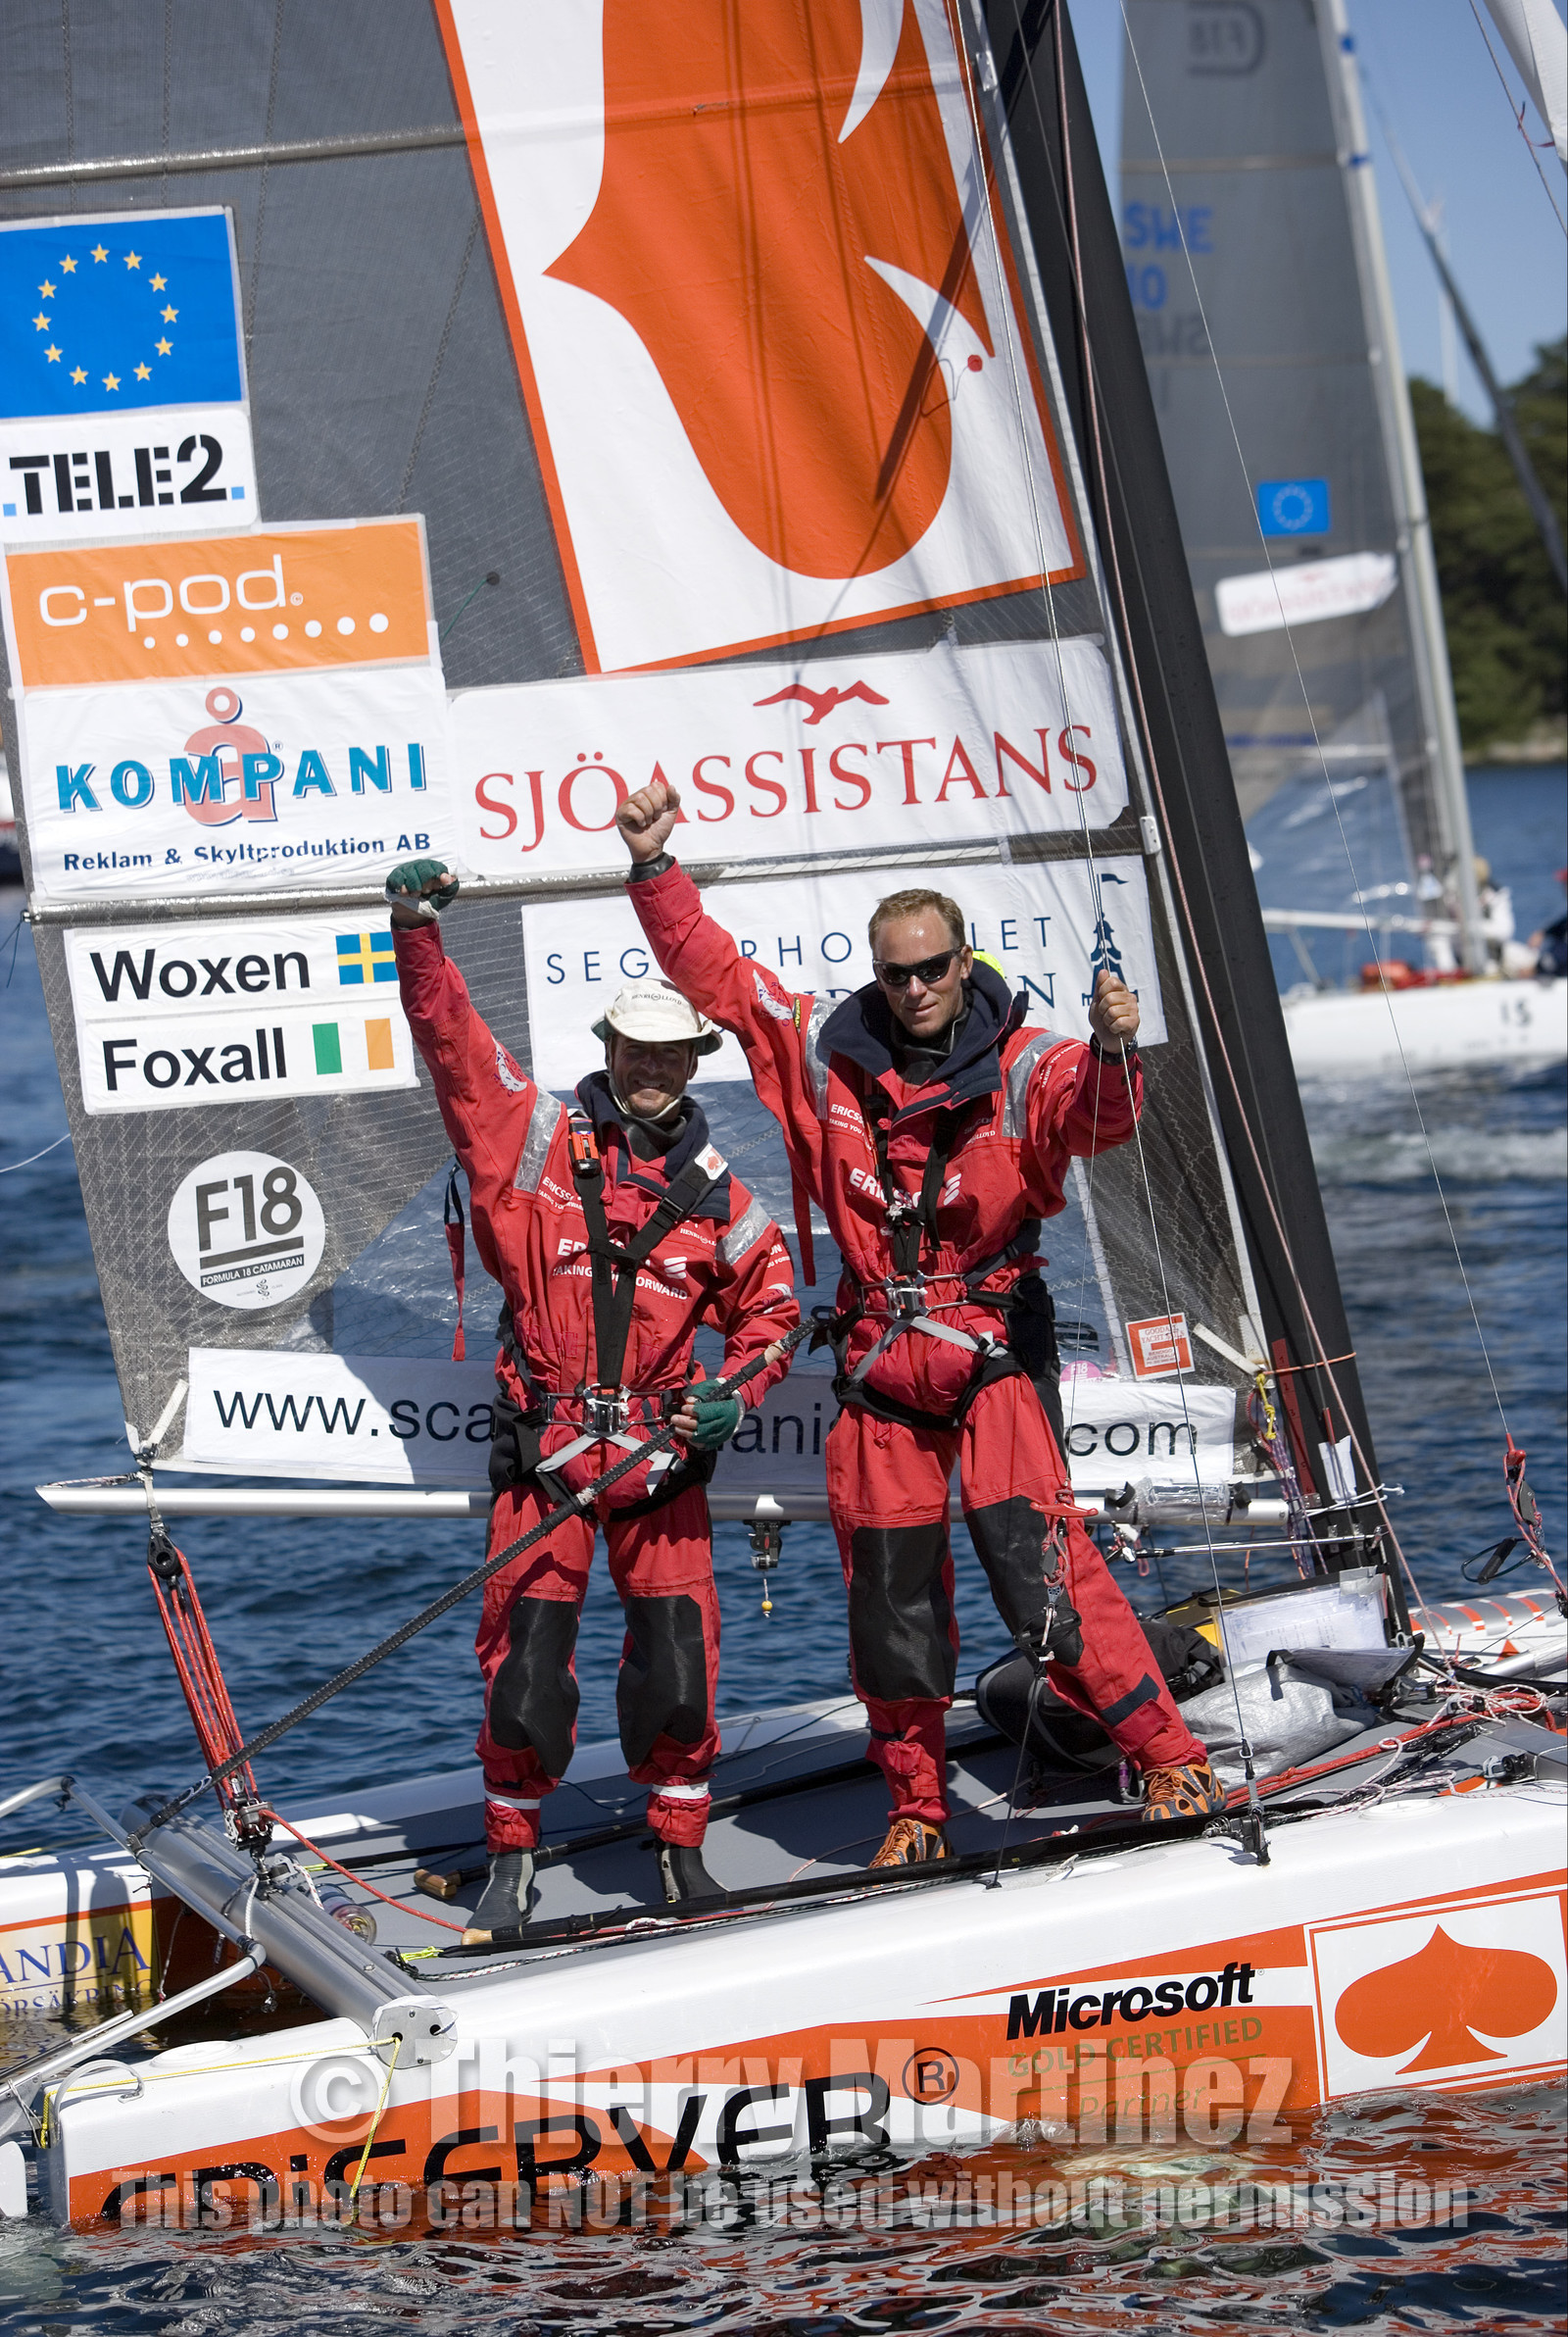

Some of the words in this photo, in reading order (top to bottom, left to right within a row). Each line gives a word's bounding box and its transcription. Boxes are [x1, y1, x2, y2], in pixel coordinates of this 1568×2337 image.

[56, 742, 426, 813] KOMPANI
[64, 852, 153, 870] Reklam
[165, 848, 183, 866] &
[396, 833, 431, 853] AB
[90, 948, 311, 1002] Woxen
[102, 1026, 287, 1092] Foxall
[196, 1167, 303, 1252] F18
[202, 1270, 240, 1286] FORMULA
[242, 1268, 252, 1277] 18
[253, 1257, 303, 1275] CATAMARAN
[635, 1276, 688, 1300] ORWARD
[1070, 1363, 1088, 1374] F18
[1006, 1962, 1255, 2041] Microsoft
[1007, 2043, 1096, 2078] GOLD
[1106, 2016, 1262, 2062] CERTIFIED
[1080, 2086, 1206, 2124] Partner
